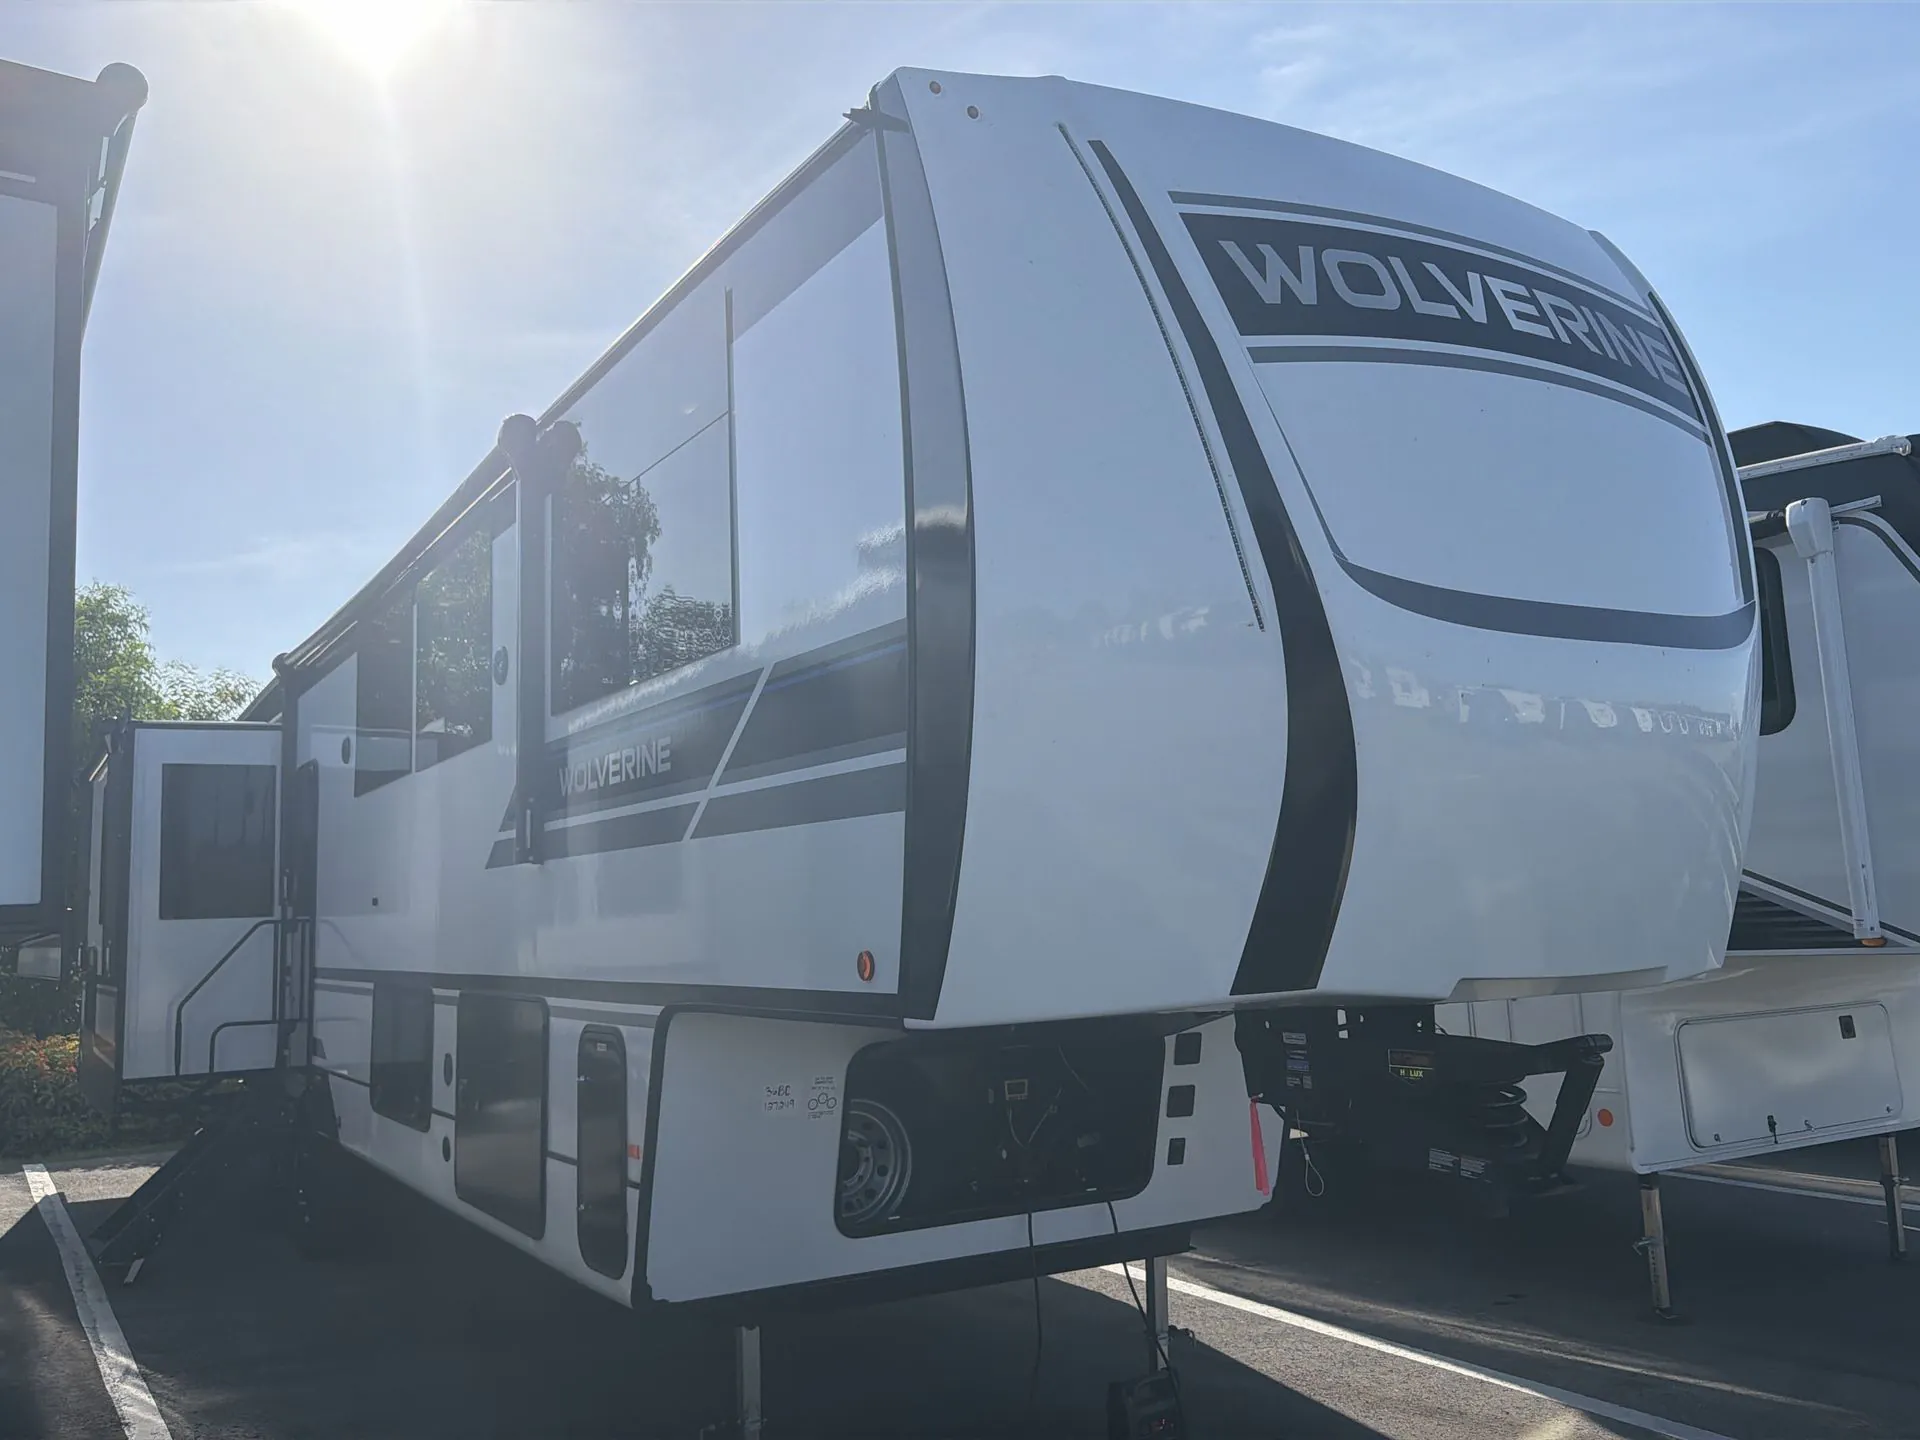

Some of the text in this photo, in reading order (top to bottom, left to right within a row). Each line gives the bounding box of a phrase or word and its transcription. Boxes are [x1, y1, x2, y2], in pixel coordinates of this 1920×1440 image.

[1219, 240, 1690, 397] WOLVERINE
[559, 736, 671, 797] WOLVERINE
[1399, 1068, 1424, 1078] HLUX
